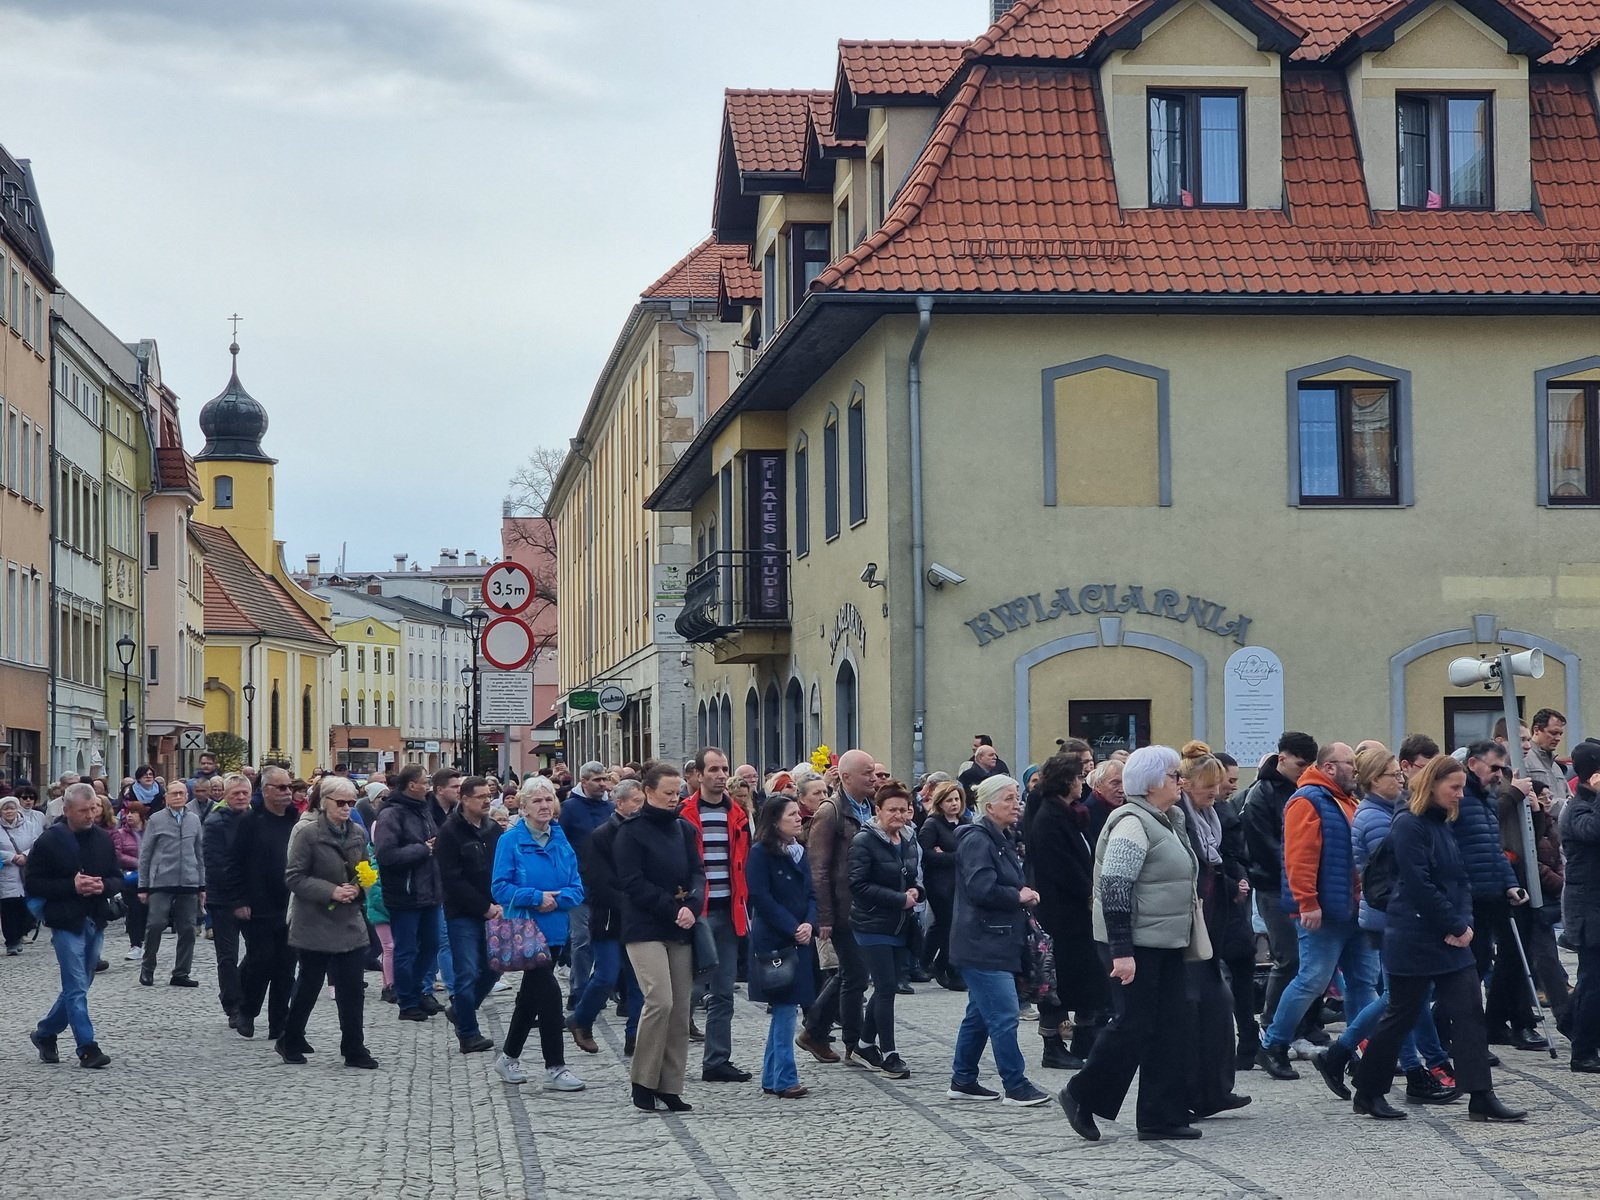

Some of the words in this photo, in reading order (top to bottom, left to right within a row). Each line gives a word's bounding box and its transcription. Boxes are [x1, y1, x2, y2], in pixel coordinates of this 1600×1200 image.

[761, 459, 779, 534] PILATES
[761, 542, 780, 609] STUDIO
[964, 584, 1252, 646] KWIACIARNIA
